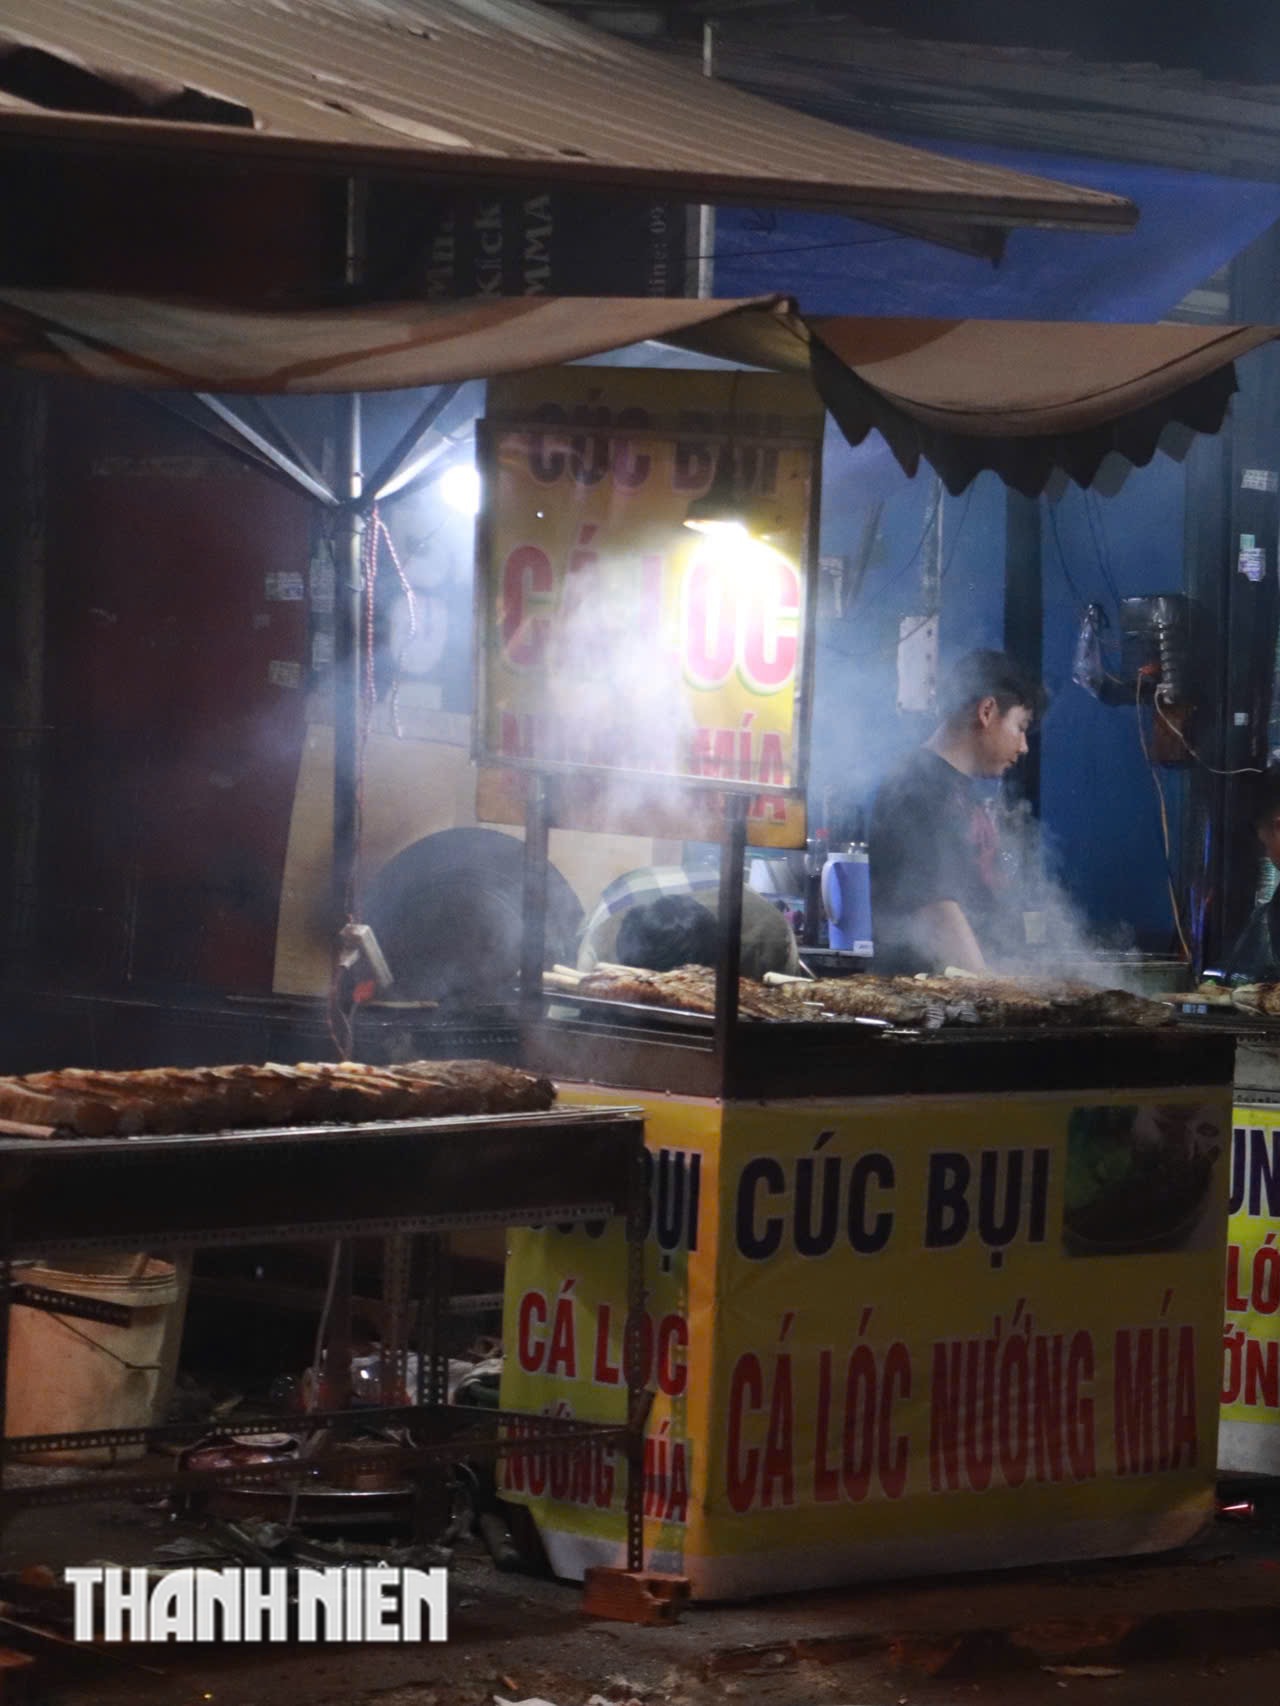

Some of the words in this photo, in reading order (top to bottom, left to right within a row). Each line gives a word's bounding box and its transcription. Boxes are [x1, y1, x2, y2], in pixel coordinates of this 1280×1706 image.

[736, 1131, 895, 1260] CÚC
[925, 1148, 1050, 1268] BỤI
[518, 1279, 576, 1378] CÁ
[726, 1312, 794, 1513] CÁ
[814, 1308, 912, 1502] LÓC
[930, 1298, 1097, 1492] NƯỚNG
[1114, 1288, 1198, 1478] MÍA
